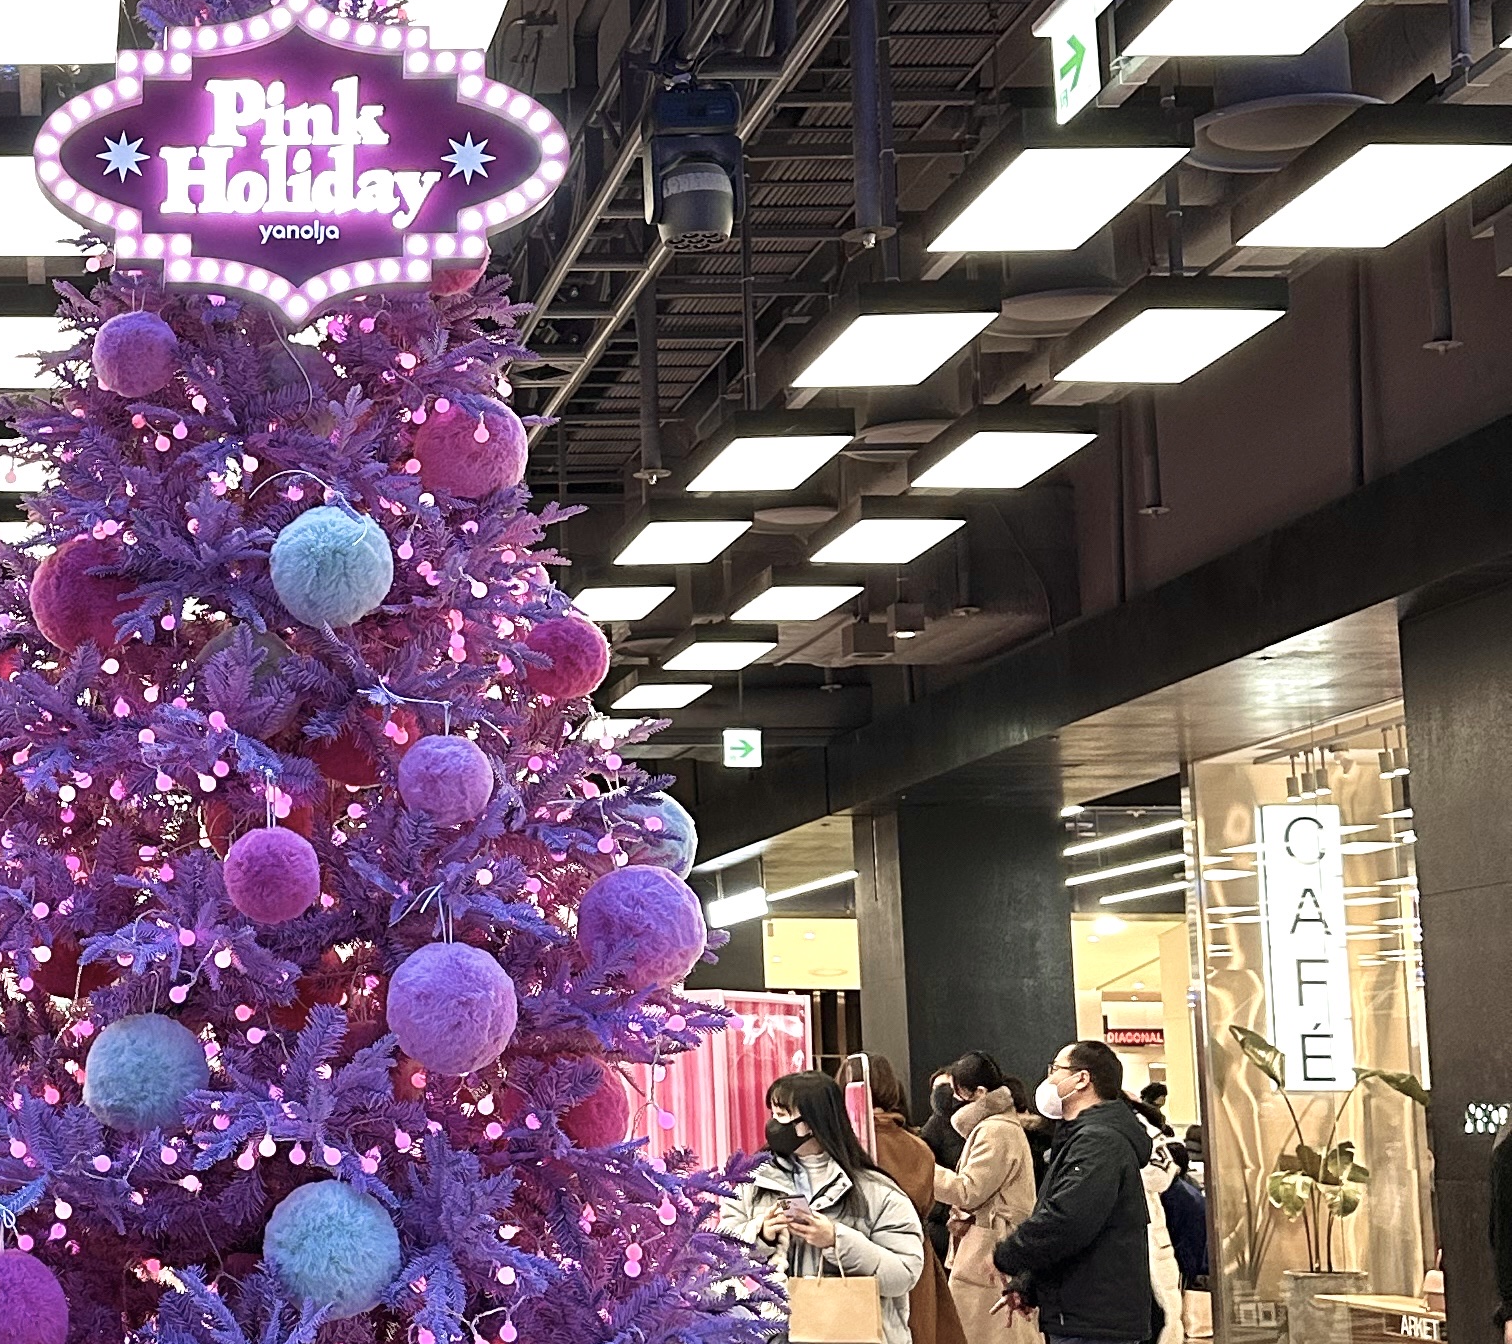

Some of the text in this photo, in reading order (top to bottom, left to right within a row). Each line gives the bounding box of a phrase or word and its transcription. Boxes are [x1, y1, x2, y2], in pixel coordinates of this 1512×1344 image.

[205, 76, 391, 146] Pink
[158, 144, 443, 230] Holiday
[258, 220, 340, 244] yanolja
[1284, 816, 1337, 1083] CAFÉ
